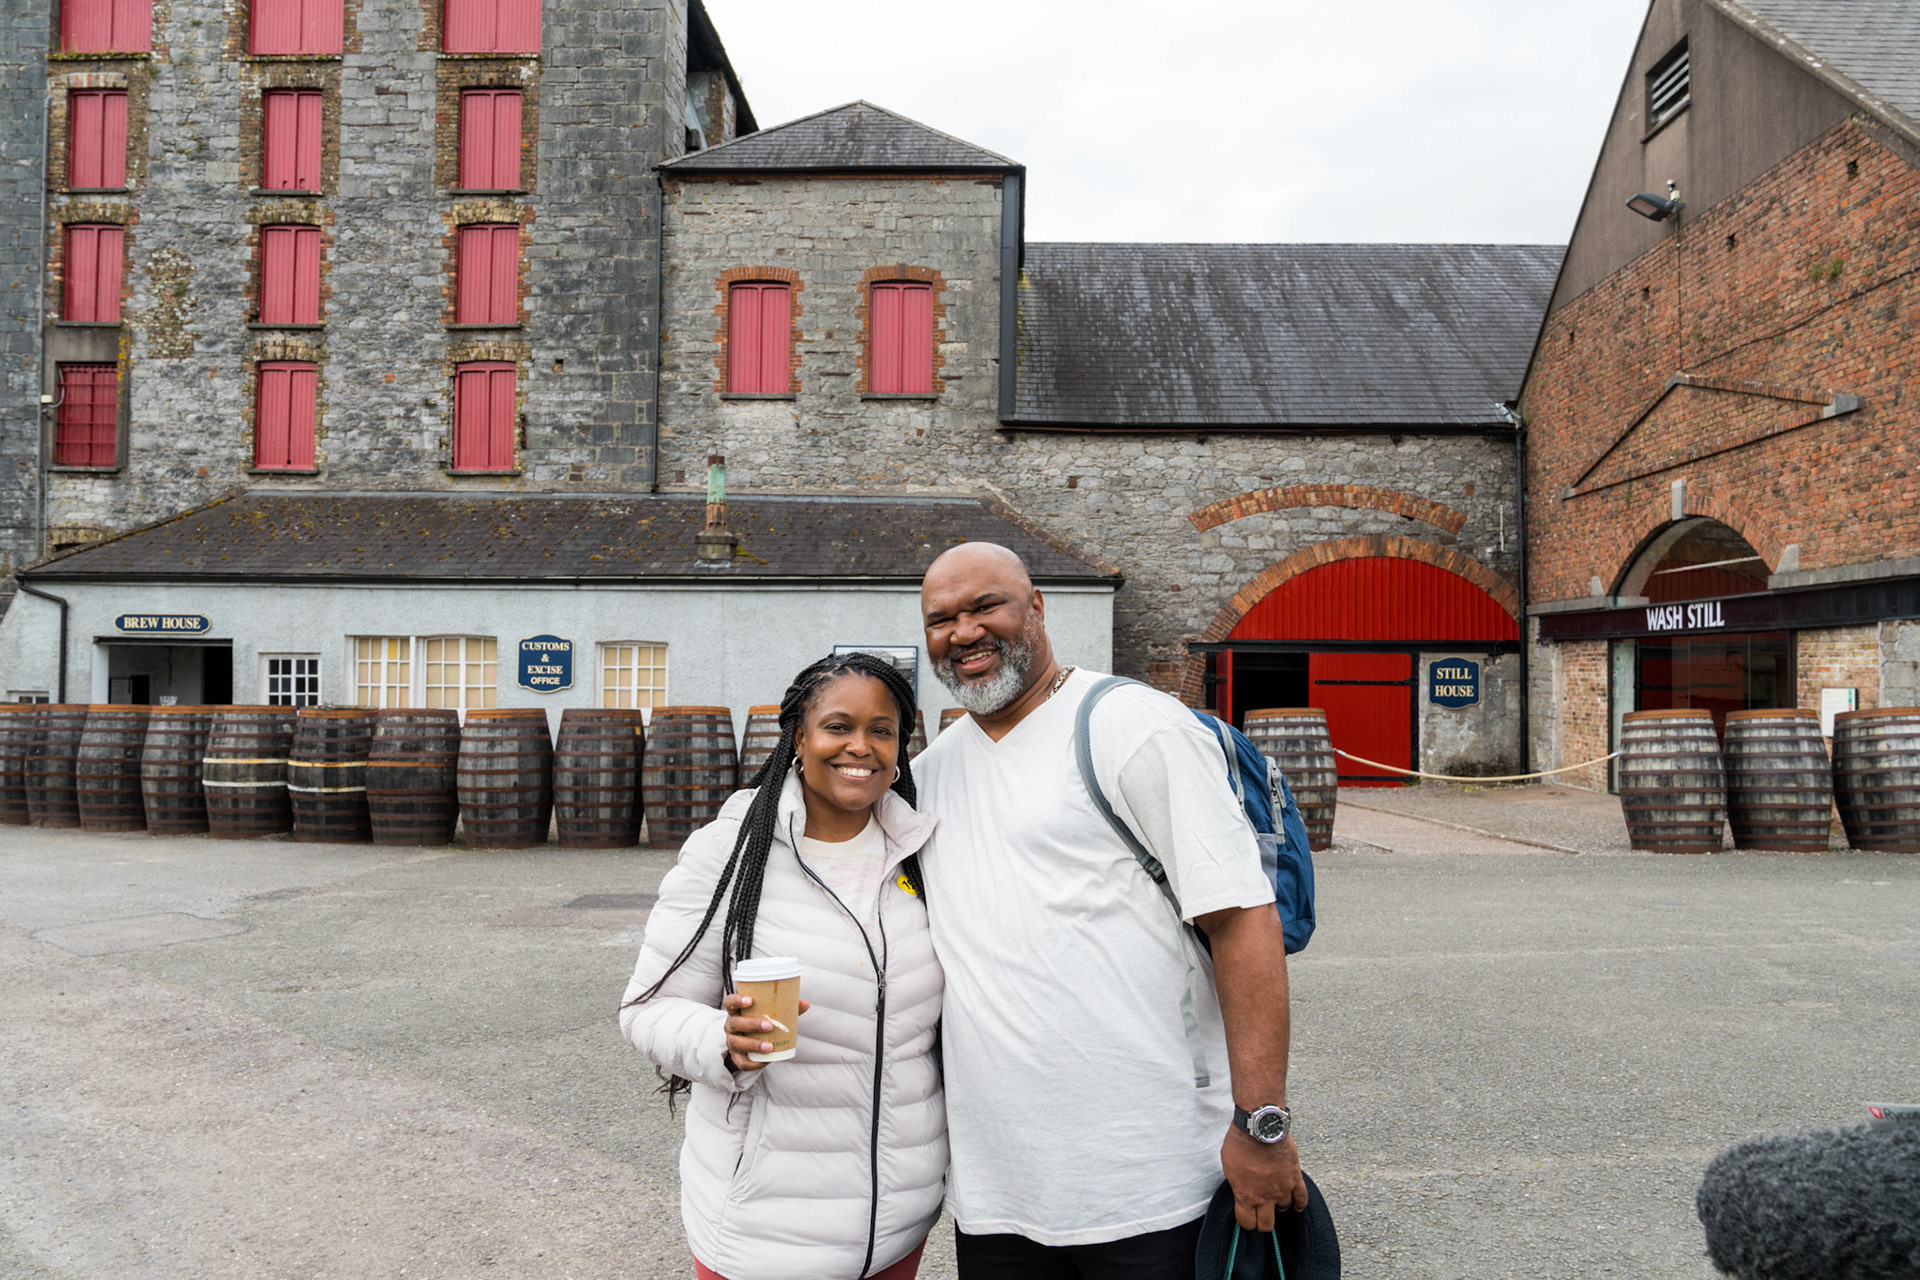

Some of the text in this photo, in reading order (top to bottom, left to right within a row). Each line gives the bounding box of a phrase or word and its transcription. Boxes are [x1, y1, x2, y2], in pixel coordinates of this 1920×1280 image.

[1646, 601, 1725, 631] WASH STILL
[123, 617, 201, 629] BREW HOUSE
[521, 641, 570, 651] CUSTOMS
[540, 653, 550, 663] &
[527, 665, 563, 674] EXCISE
[1436, 667, 1472, 679] STILL
[530, 676, 560, 685] OFFICE
[1434, 684, 1475, 697] HOUSE
